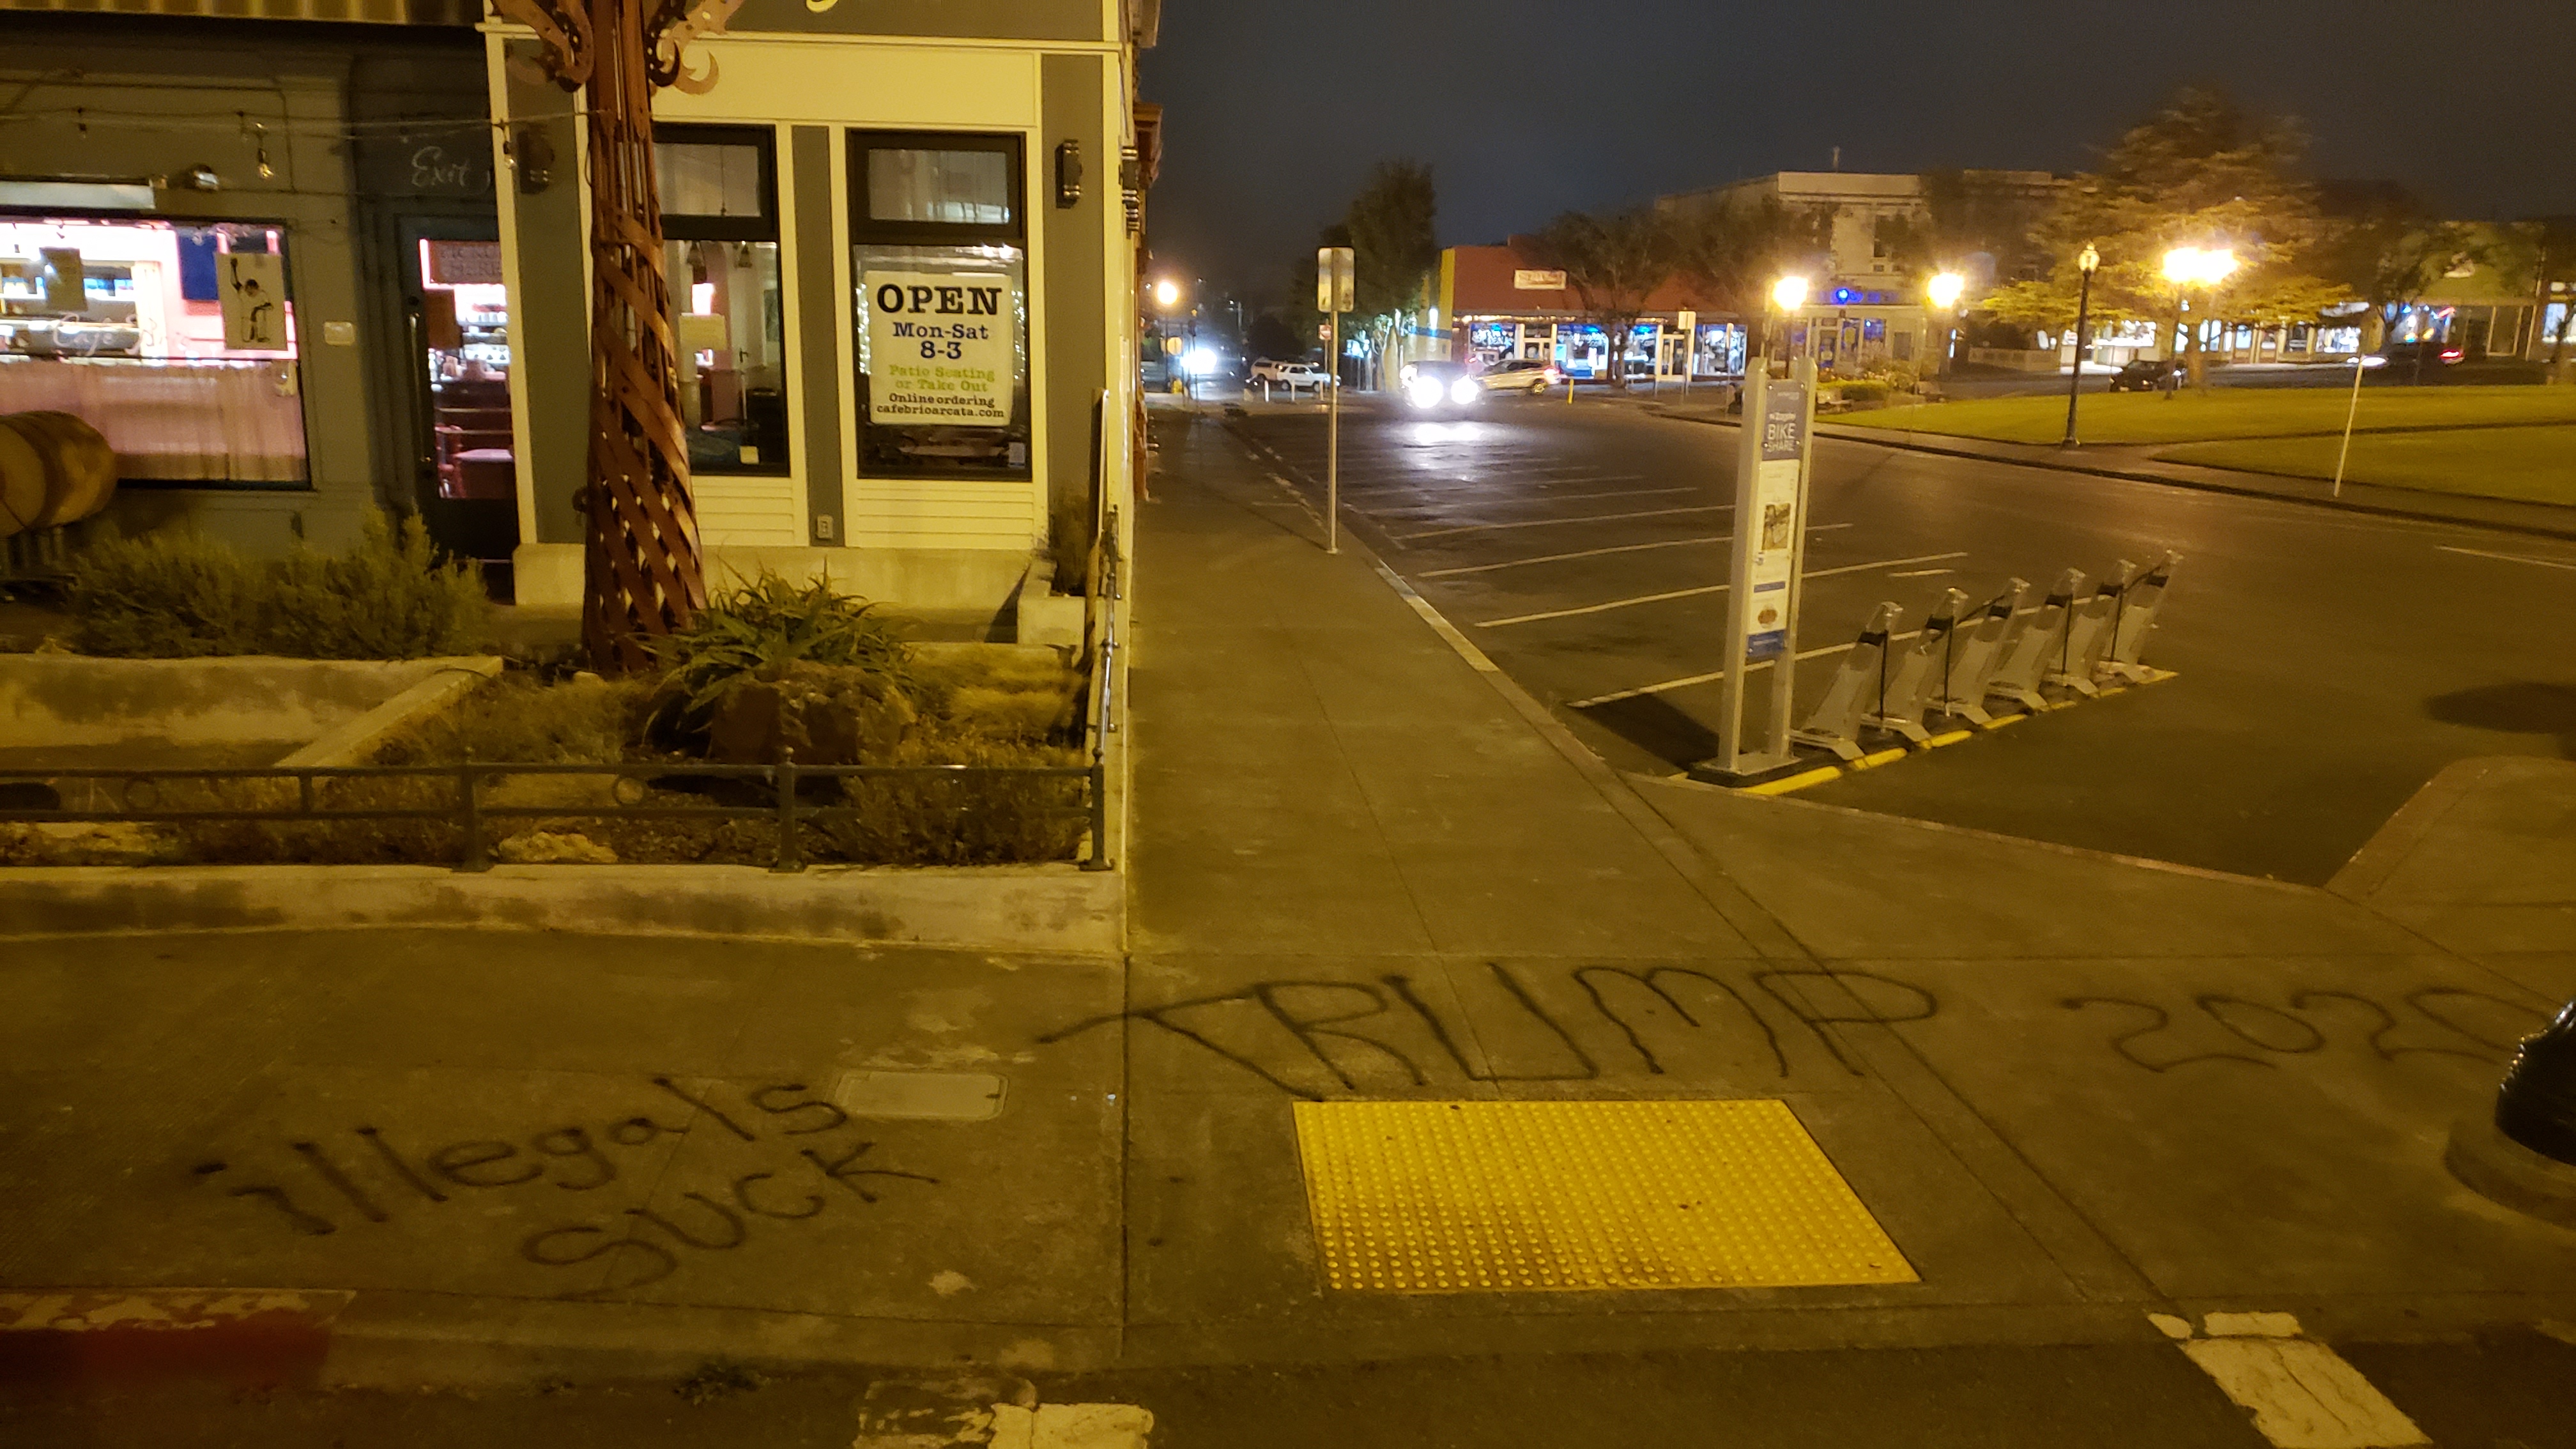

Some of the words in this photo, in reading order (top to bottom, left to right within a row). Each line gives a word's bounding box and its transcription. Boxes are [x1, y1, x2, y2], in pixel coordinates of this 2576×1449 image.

[411, 146, 470, 188] Exit
[877, 284, 1002, 315] OPEN
[893, 321, 988, 340] Mon-Sat
[921, 341, 962, 359] 8-3
[889, 364, 930, 377] Patio
[935, 367, 995, 382] Seating
[917, 381, 955, 391] Take
[960, 381, 988, 392] Out
[889, 393, 935, 404] Online
[937, 395, 995, 408] ordering
[877, 405, 1004, 418] cafebrioarcata.com
[1767, 422, 1796, 440] BIKE
[1767, 440, 1795, 452] SHARE
[1031, 960, 1938, 1103] TRUMP
[2053, 986, 2554, 1073] 2020
[193, 1076, 847, 1236] illegals
[521, 1141, 939, 1298] SUCK
